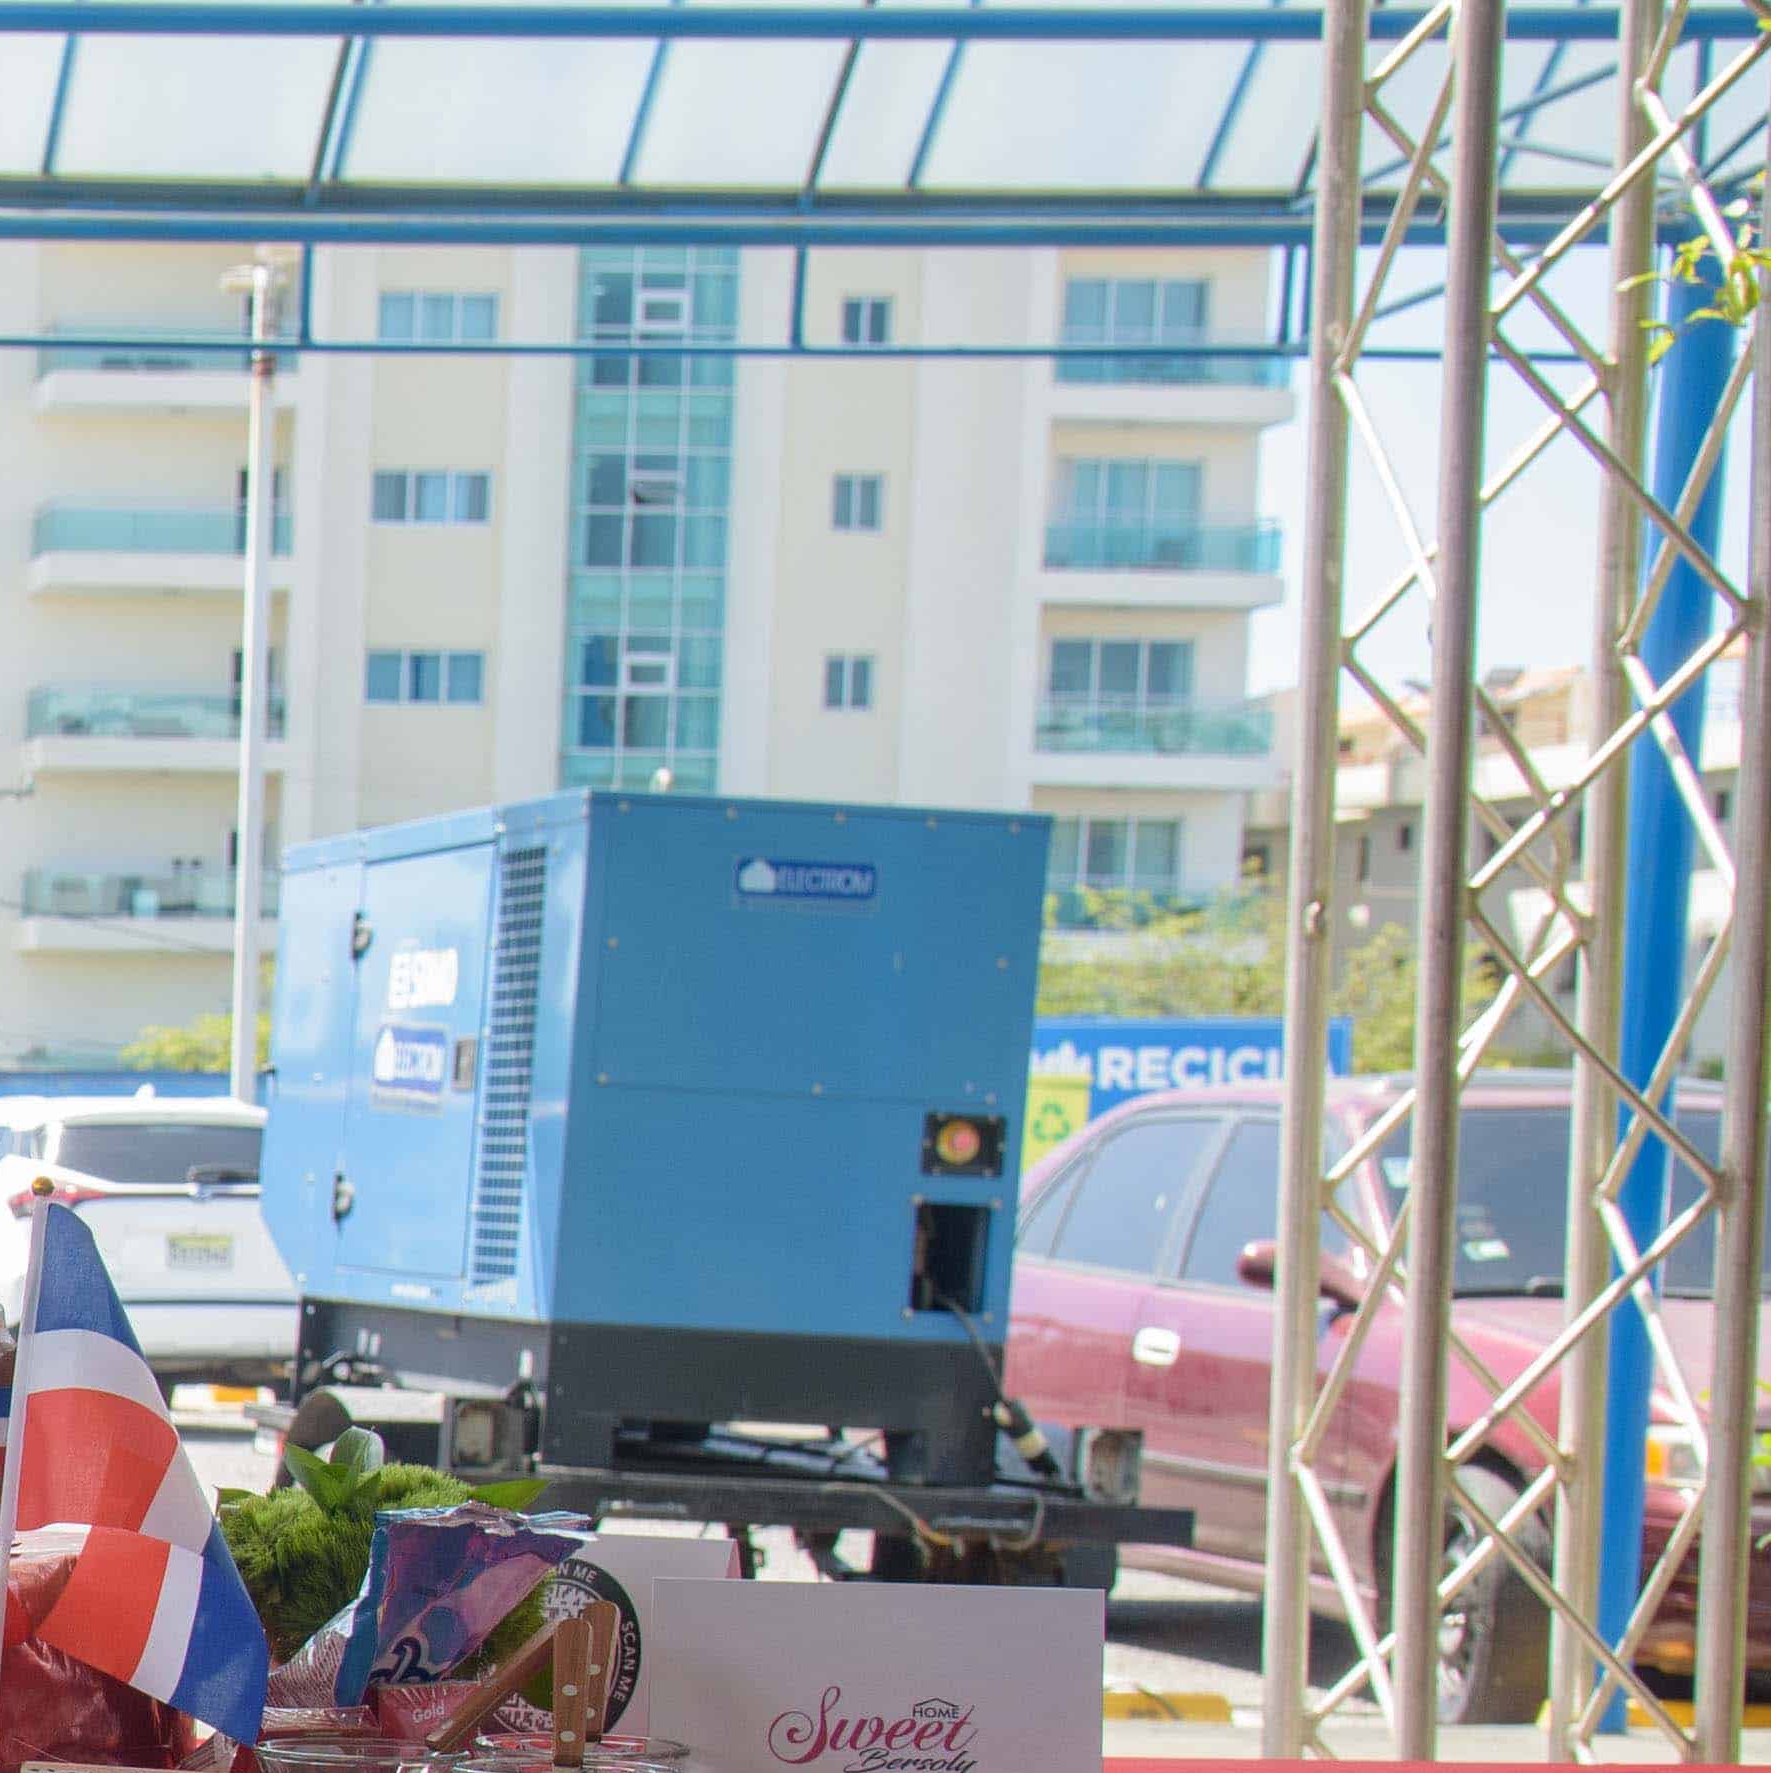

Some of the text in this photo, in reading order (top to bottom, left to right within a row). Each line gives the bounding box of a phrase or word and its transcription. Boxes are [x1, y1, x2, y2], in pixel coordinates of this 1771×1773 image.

[1098, 1046, 1335, 1091] RECICL
[621, 1620, 637, 1671] SCAN
[613, 1676, 632, 1701] ME
[412, 1702, 445, 1724] Gold
[767, 1685, 980, 1764] Sweet
[912, 1706, 960, 1720] HOME
